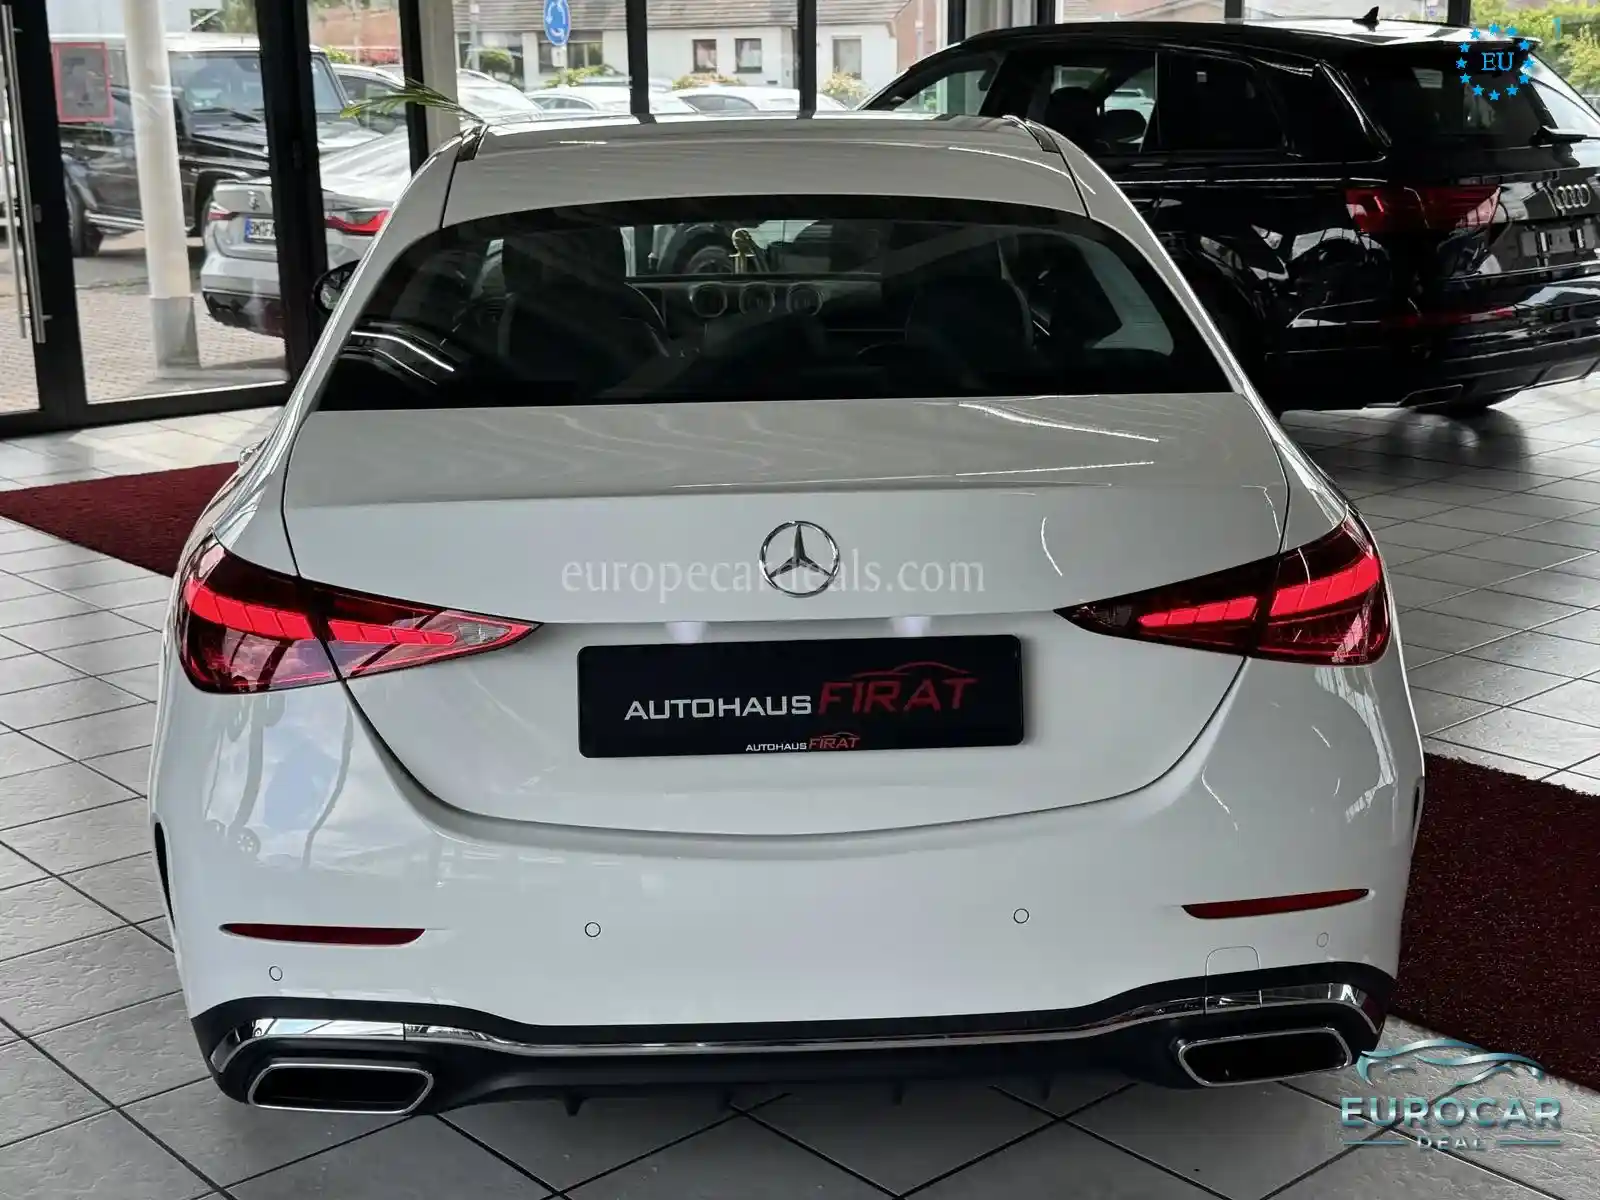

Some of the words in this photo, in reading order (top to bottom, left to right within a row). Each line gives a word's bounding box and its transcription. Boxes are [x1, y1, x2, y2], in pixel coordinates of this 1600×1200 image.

[624, 695, 812, 721] AUTOHAUS
[818, 677, 979, 715] FIRAT
[745, 742, 808, 752] AUTOHAUS
[808, 737, 861, 750] FIRAT
